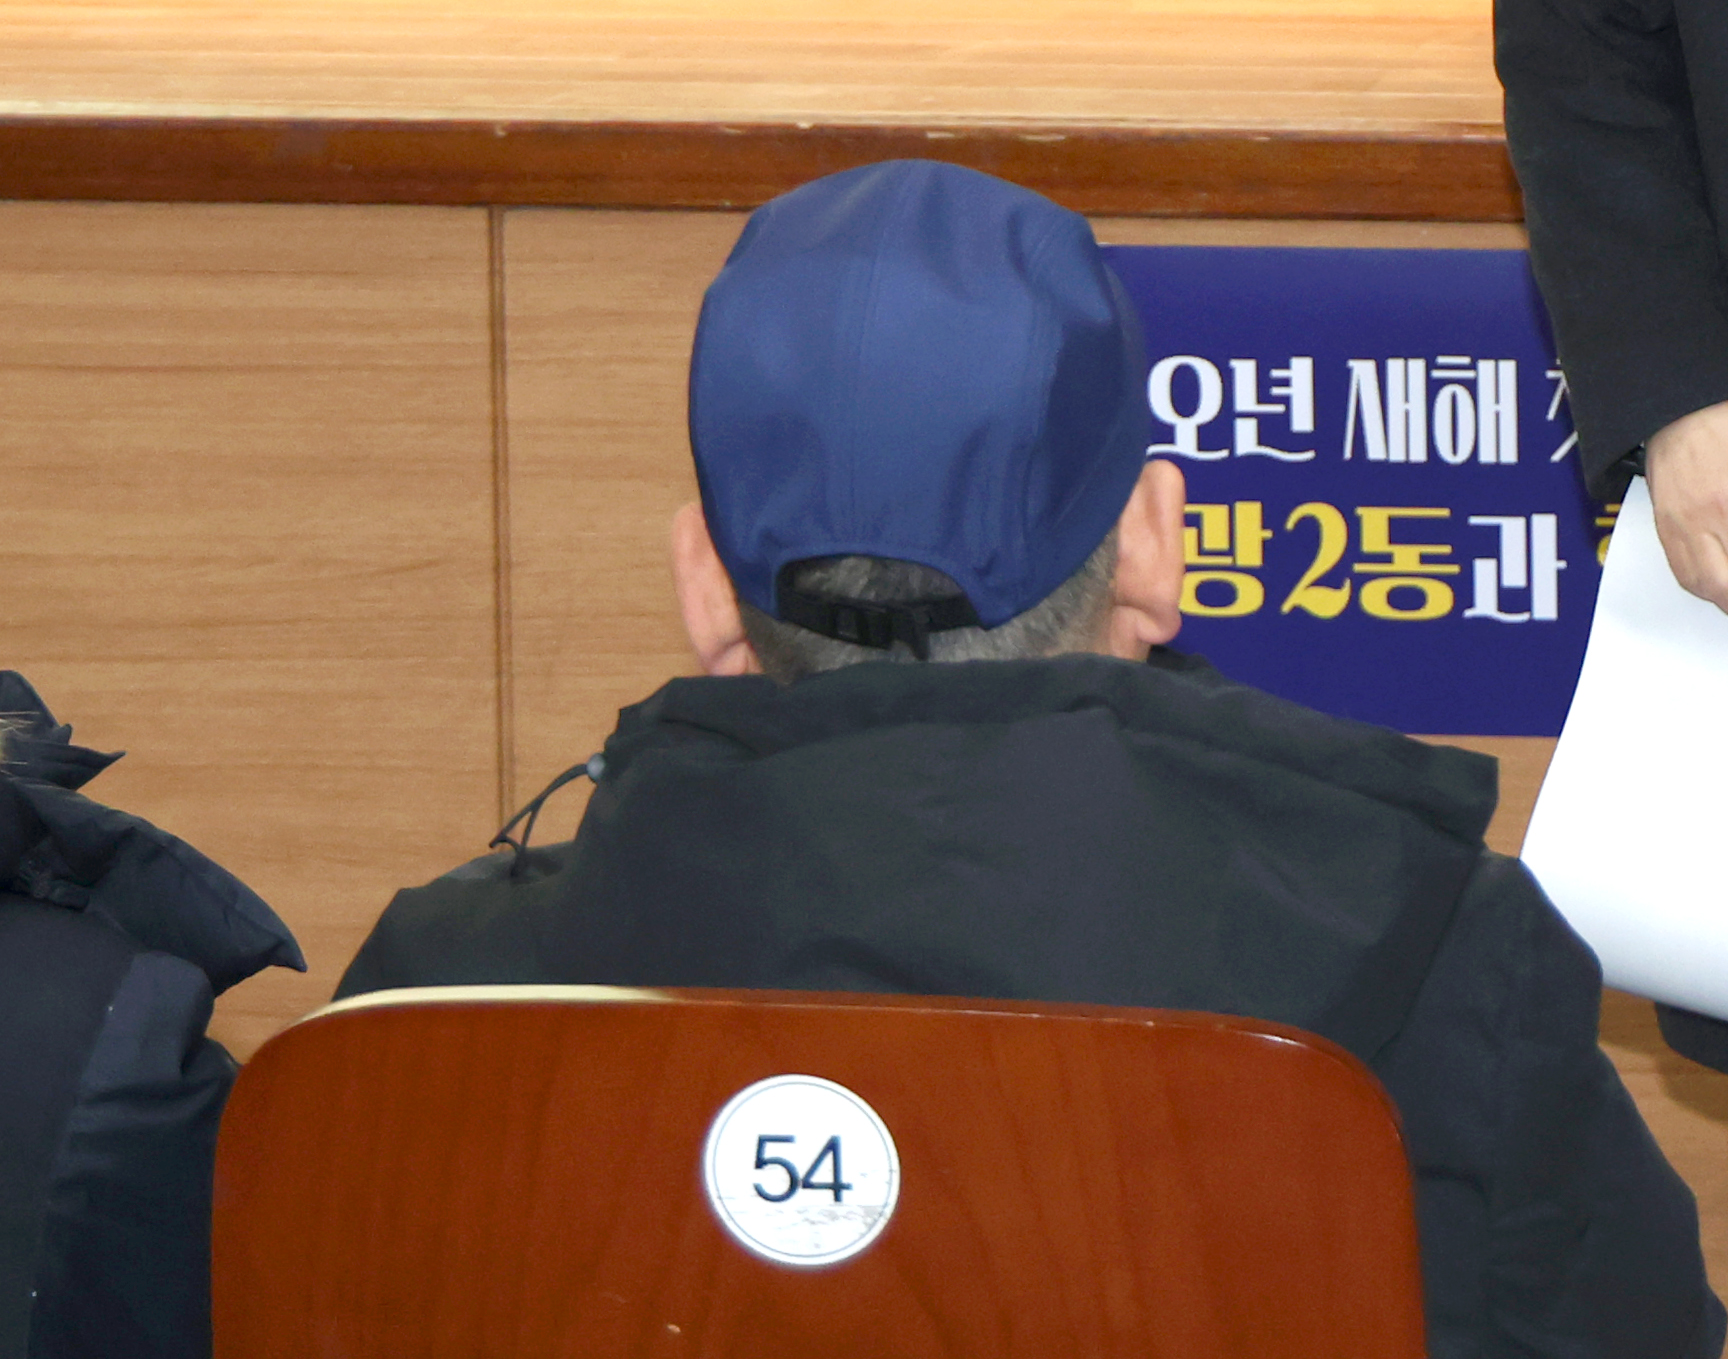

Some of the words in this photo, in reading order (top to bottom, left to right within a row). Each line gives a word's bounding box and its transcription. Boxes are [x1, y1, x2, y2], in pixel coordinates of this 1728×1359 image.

[1145, 355, 1316, 461] 오년
[1343, 355, 1519, 464] 새해
[1178, 501, 1567, 621] 광2동과
[753, 1134, 853, 1203] 54
